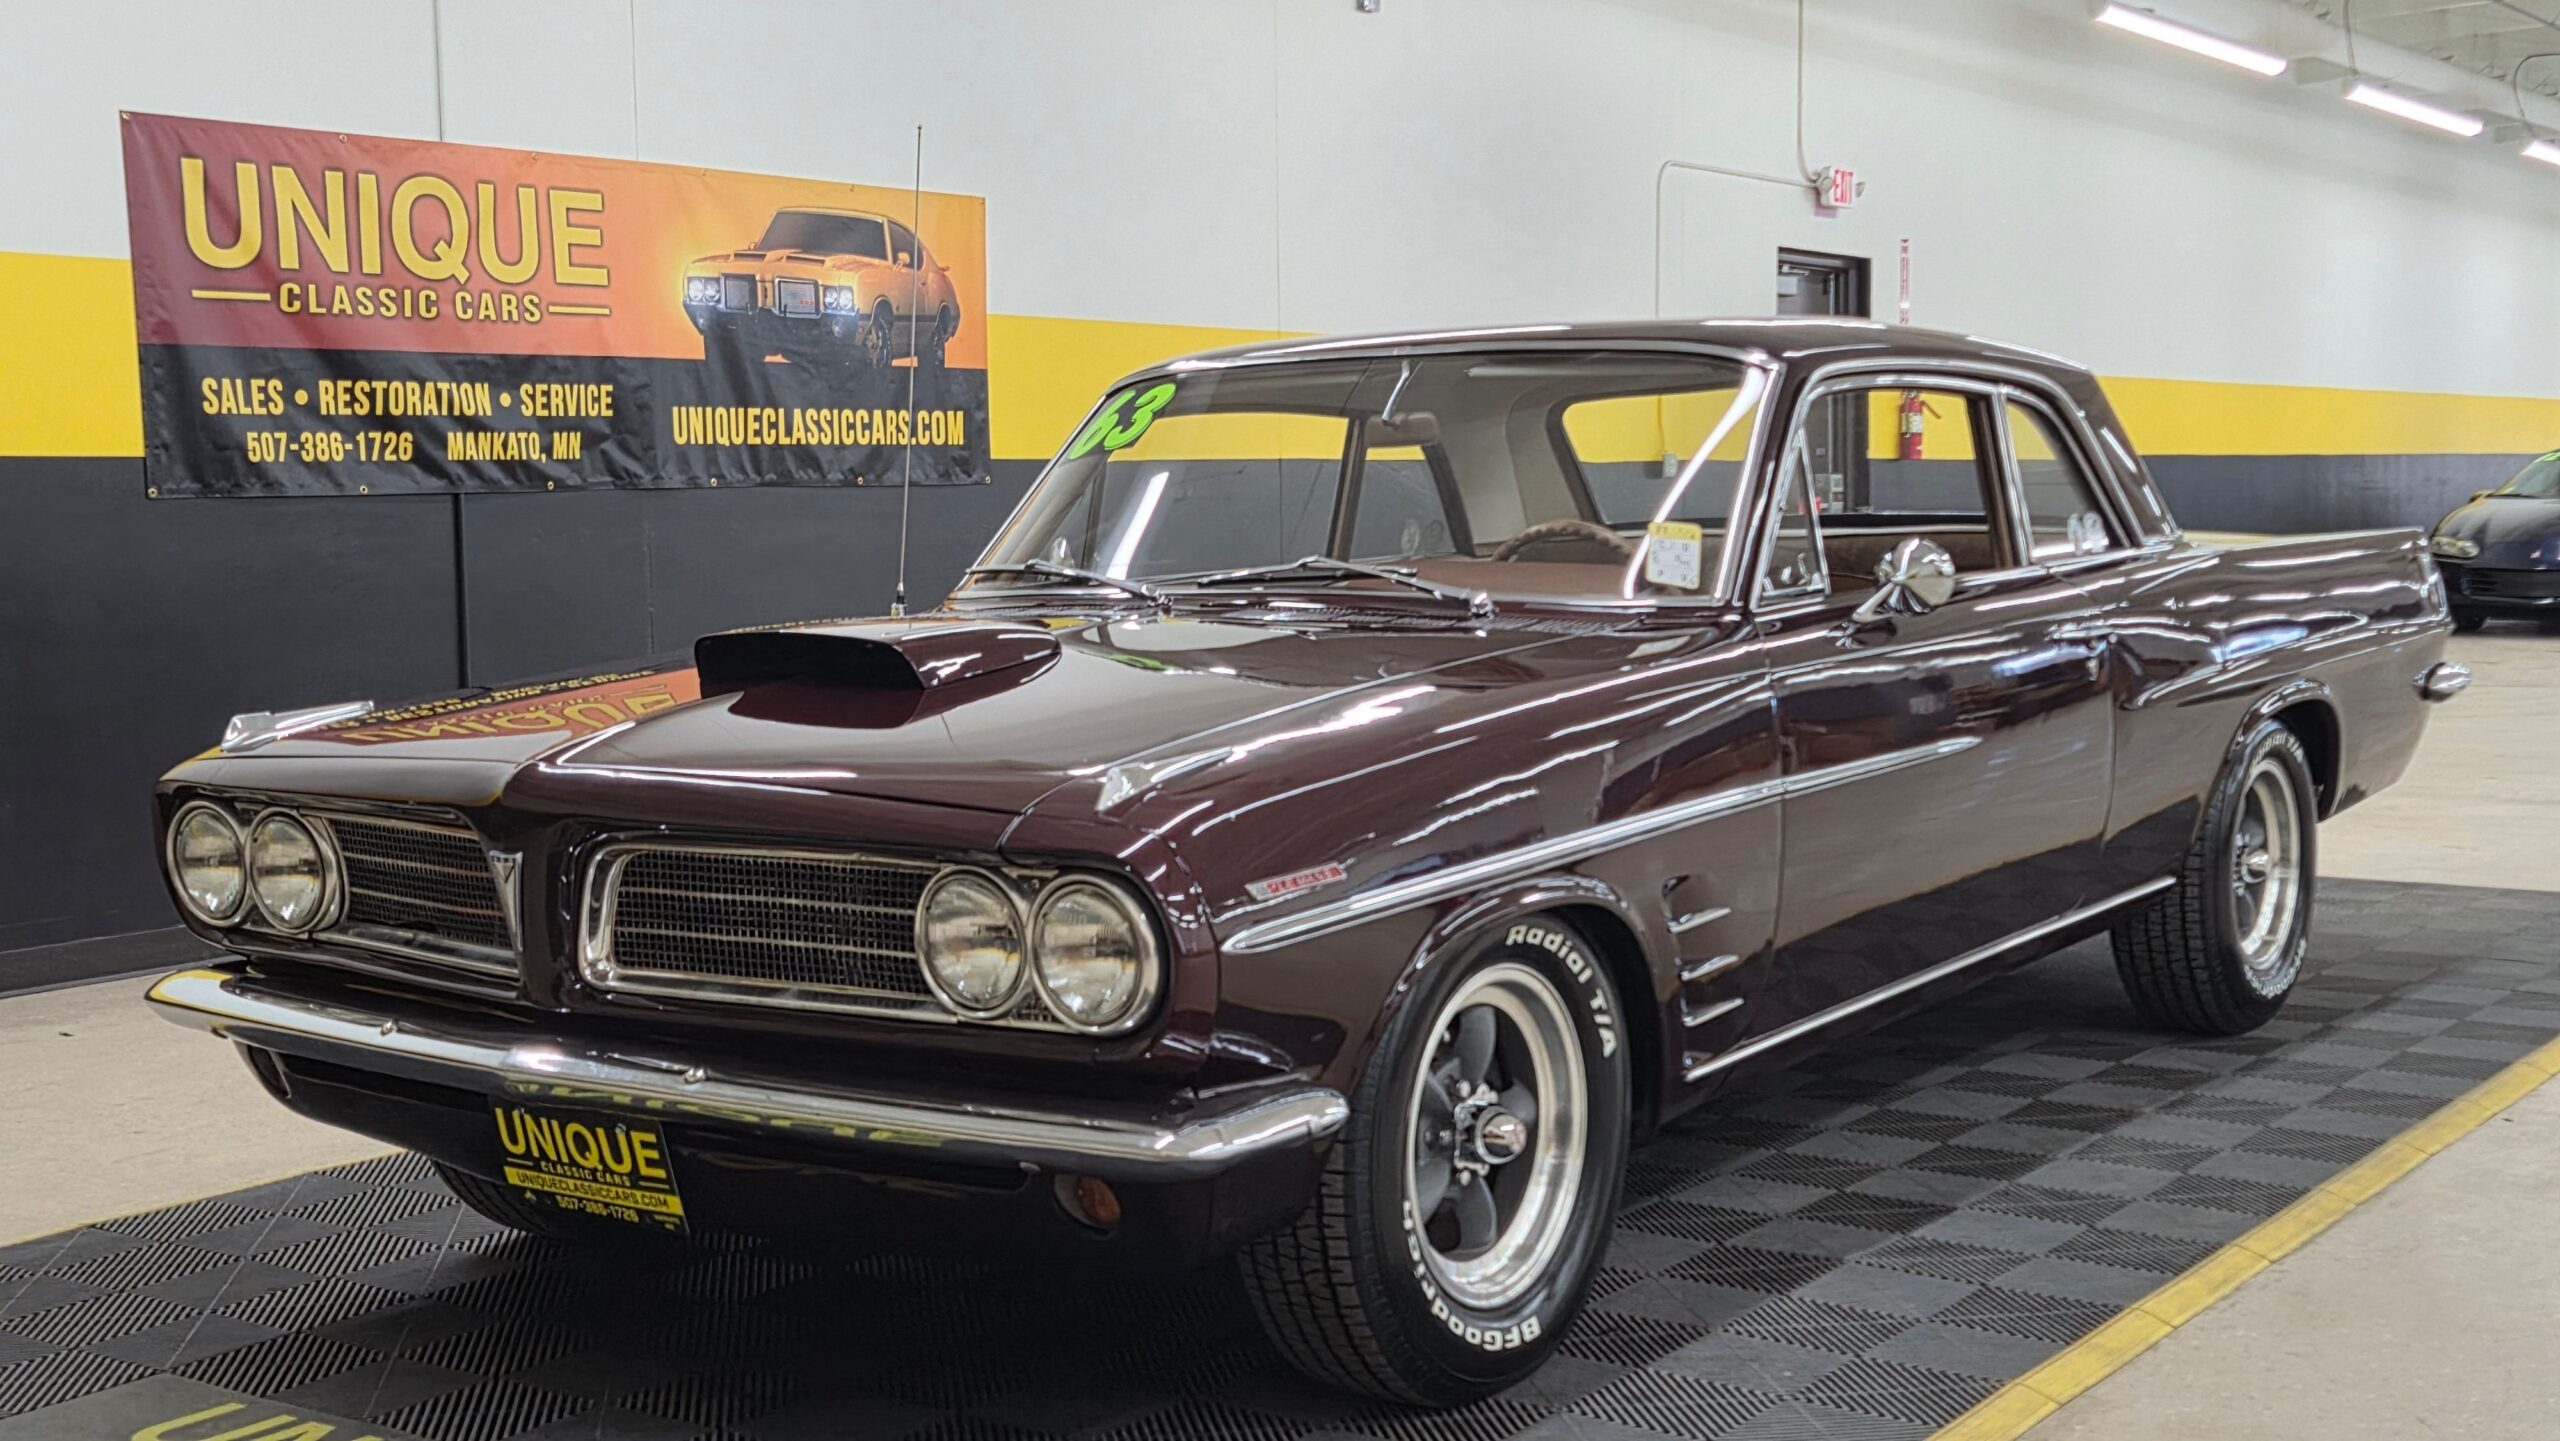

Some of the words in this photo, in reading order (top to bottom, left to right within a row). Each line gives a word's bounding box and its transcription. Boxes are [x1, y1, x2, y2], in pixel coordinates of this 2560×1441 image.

[180, 156, 609, 286] UNIQUE
[279, 282, 439, 319] CLASSIC
[455, 291, 542, 323] CARS
[202, 377, 285, 416] SALES
[319, 379, 493, 416] RESTORATION
[520, 383, 614, 417] SERVICE
[1069, 382, 1176, 460] 63
[247, 431, 414, 463] 507-386-1726
[447, 431, 546, 463] MANKATO,
[553, 431, 581, 460] MN
[672, 406, 964, 446] UNIQUECLASSICCARS.COM
[1505, 924, 1593, 984] Radial
[495, 1107, 667, 1179] UNIQUE
